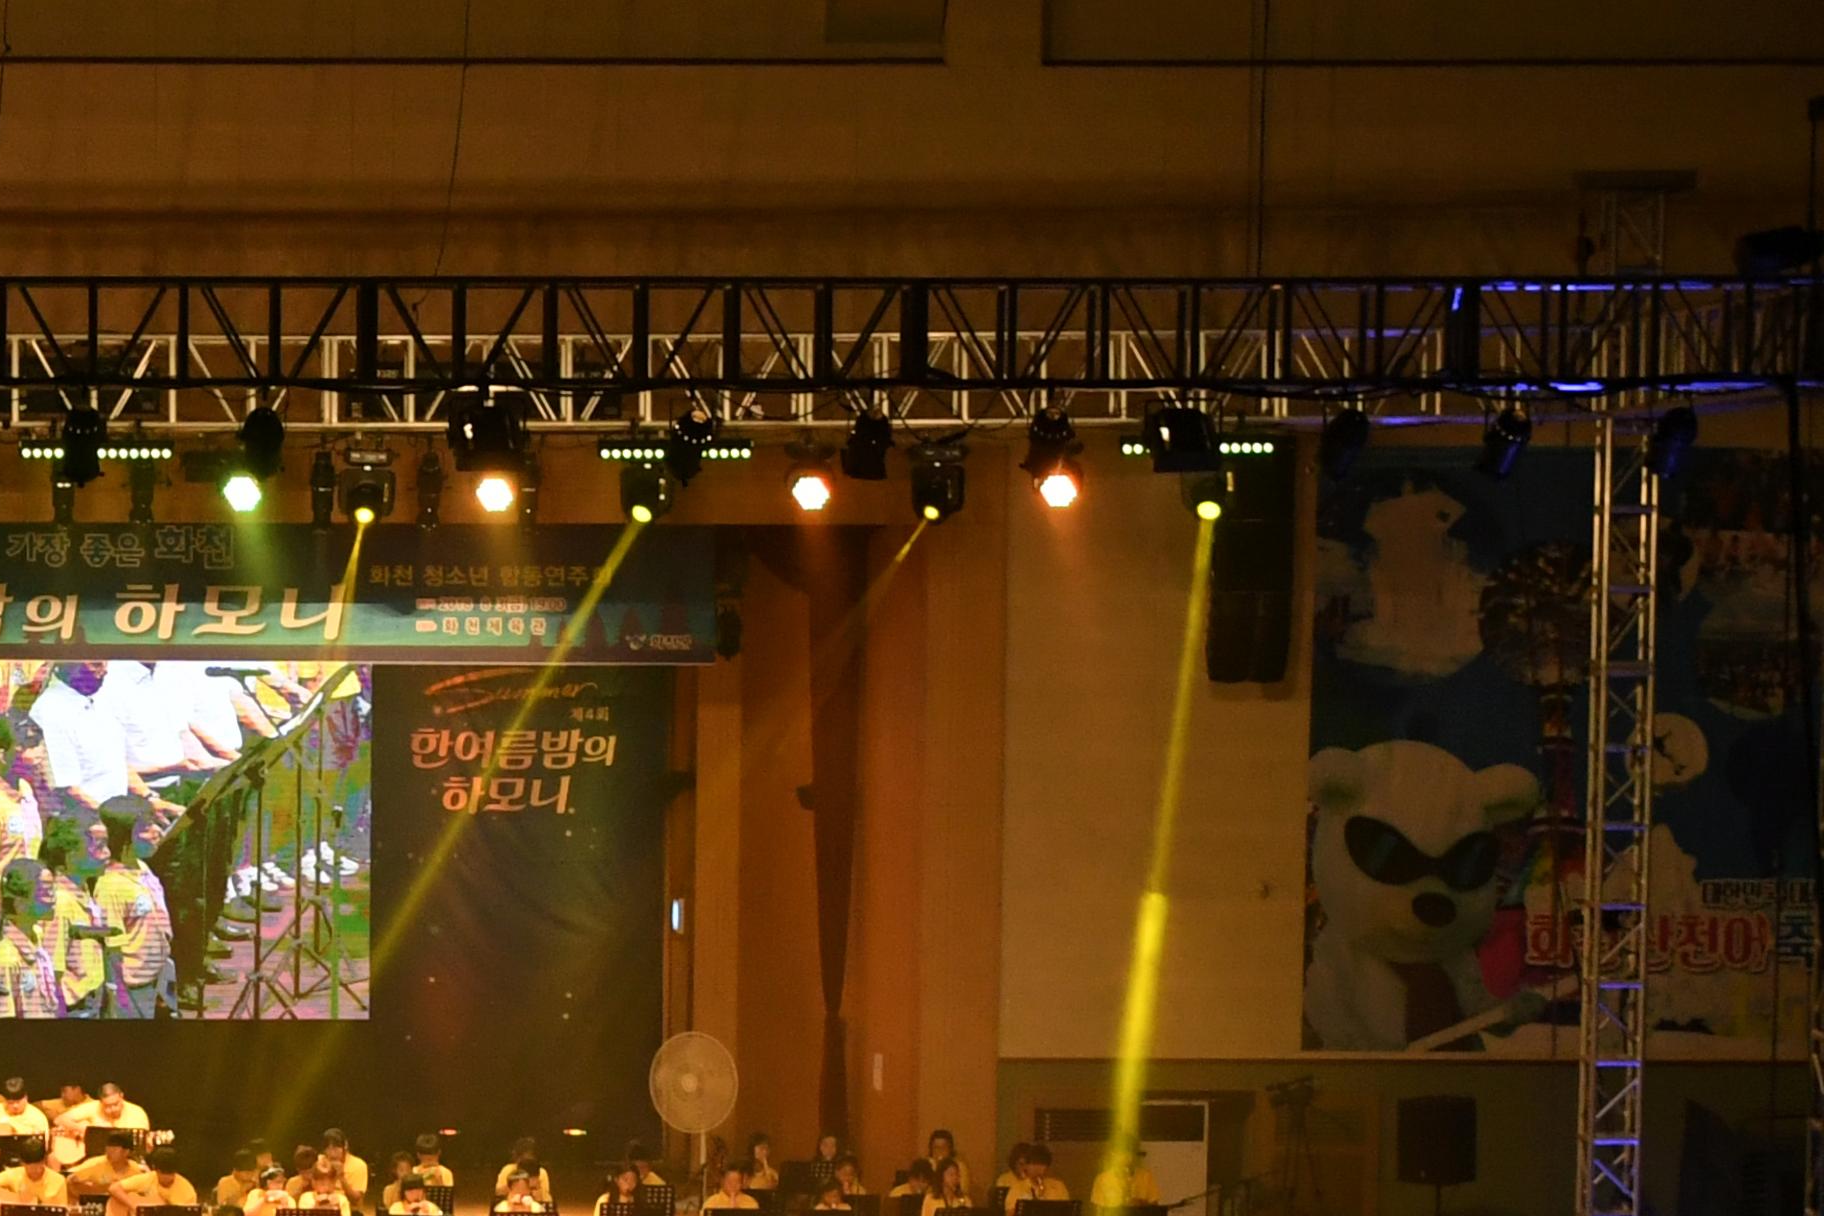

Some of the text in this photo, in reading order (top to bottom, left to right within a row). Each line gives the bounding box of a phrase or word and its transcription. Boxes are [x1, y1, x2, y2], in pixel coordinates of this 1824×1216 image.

[5, 528, 71, 568] 가장
[79, 531, 145, 568] 좋은
[154, 525, 235, 570] 화천
[424, 565, 489, 588] 청소년
[114, 582, 348, 641] 하모니
[409, 727, 618, 771] 한여름밤의
[441, 774, 572, 815] 하모니
